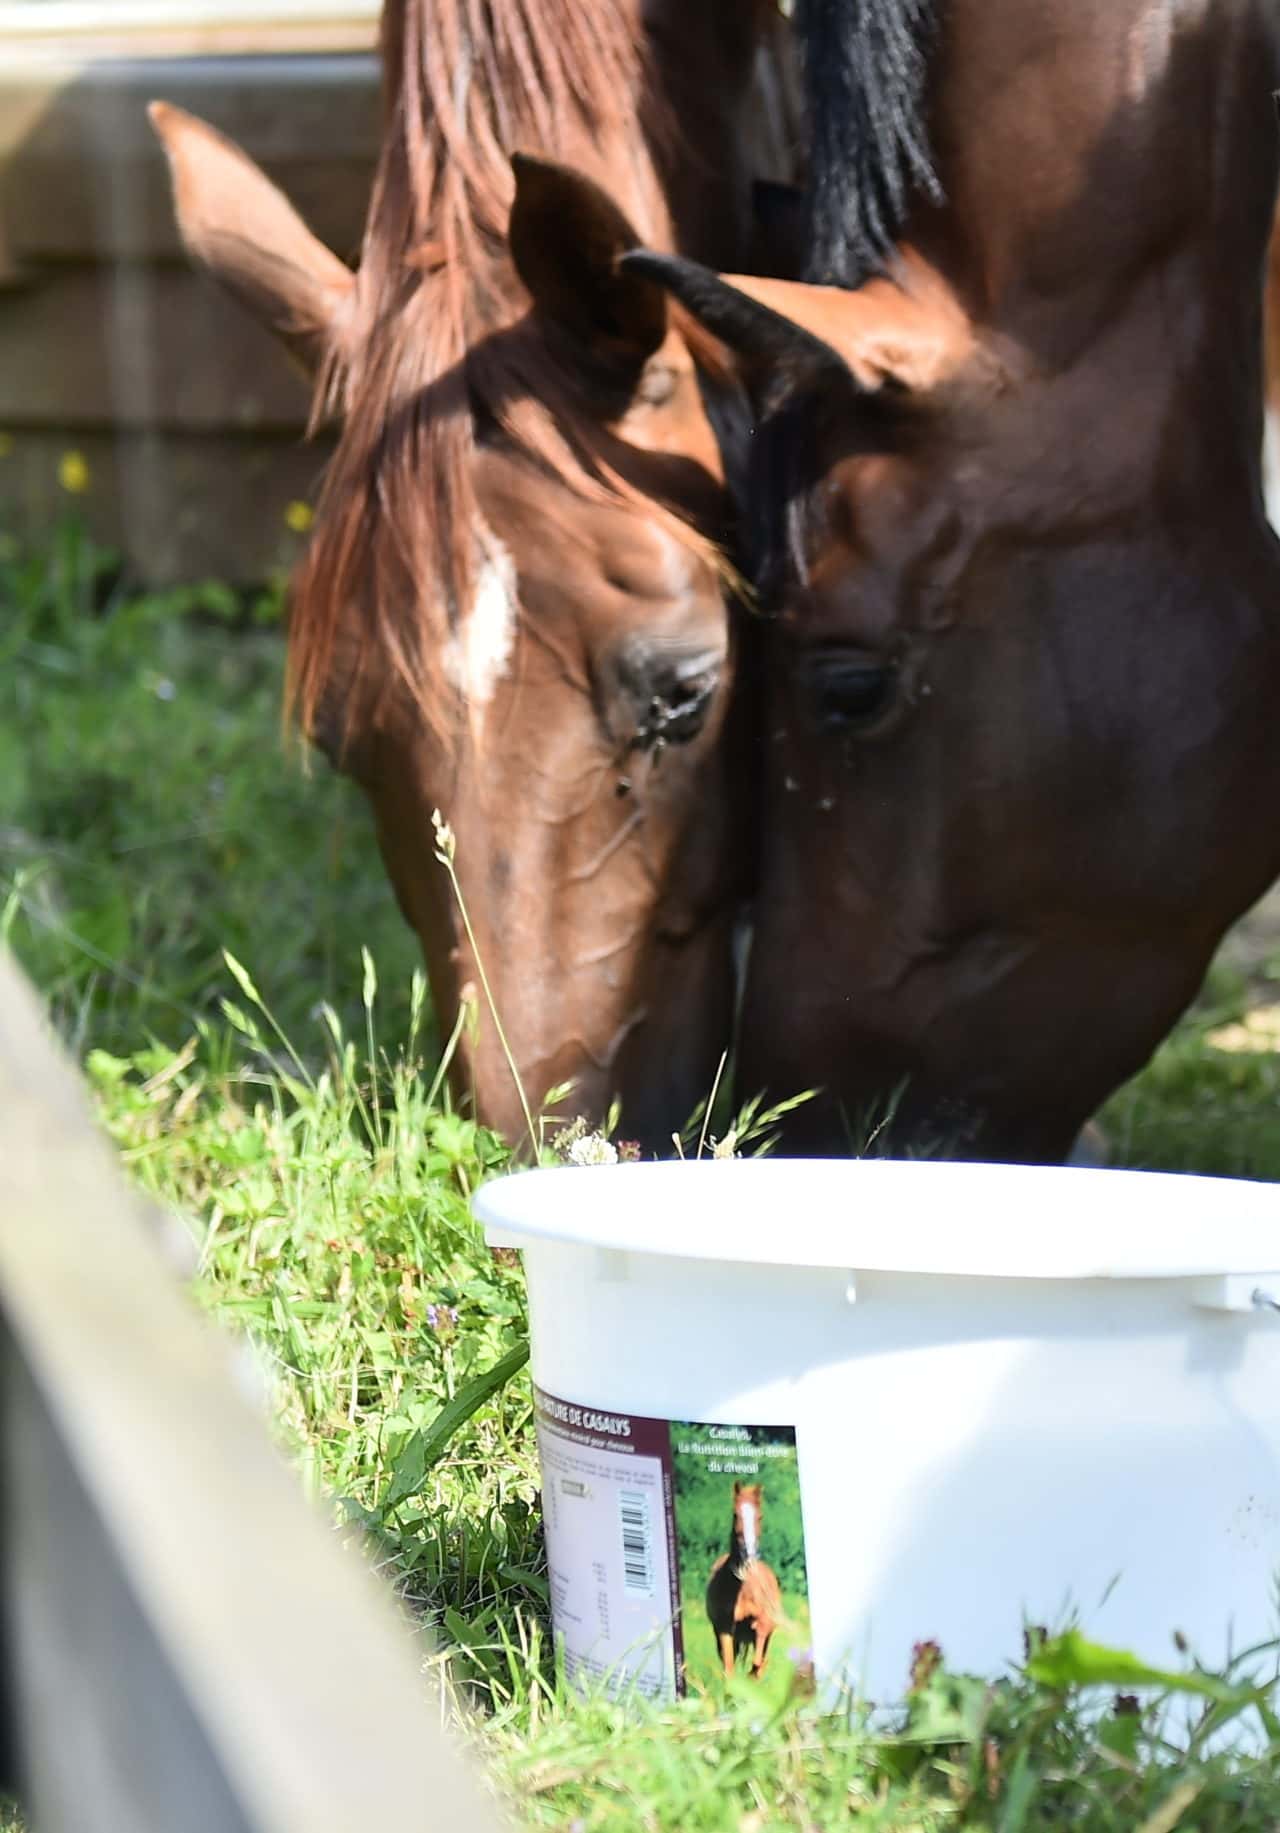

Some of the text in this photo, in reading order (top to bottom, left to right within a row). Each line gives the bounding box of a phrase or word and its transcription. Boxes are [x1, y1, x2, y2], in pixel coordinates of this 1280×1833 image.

[569, 1408, 582, 1426] DE
[583, 1413, 631, 1436] CASALYS
[708, 1461, 721, 1472] du
